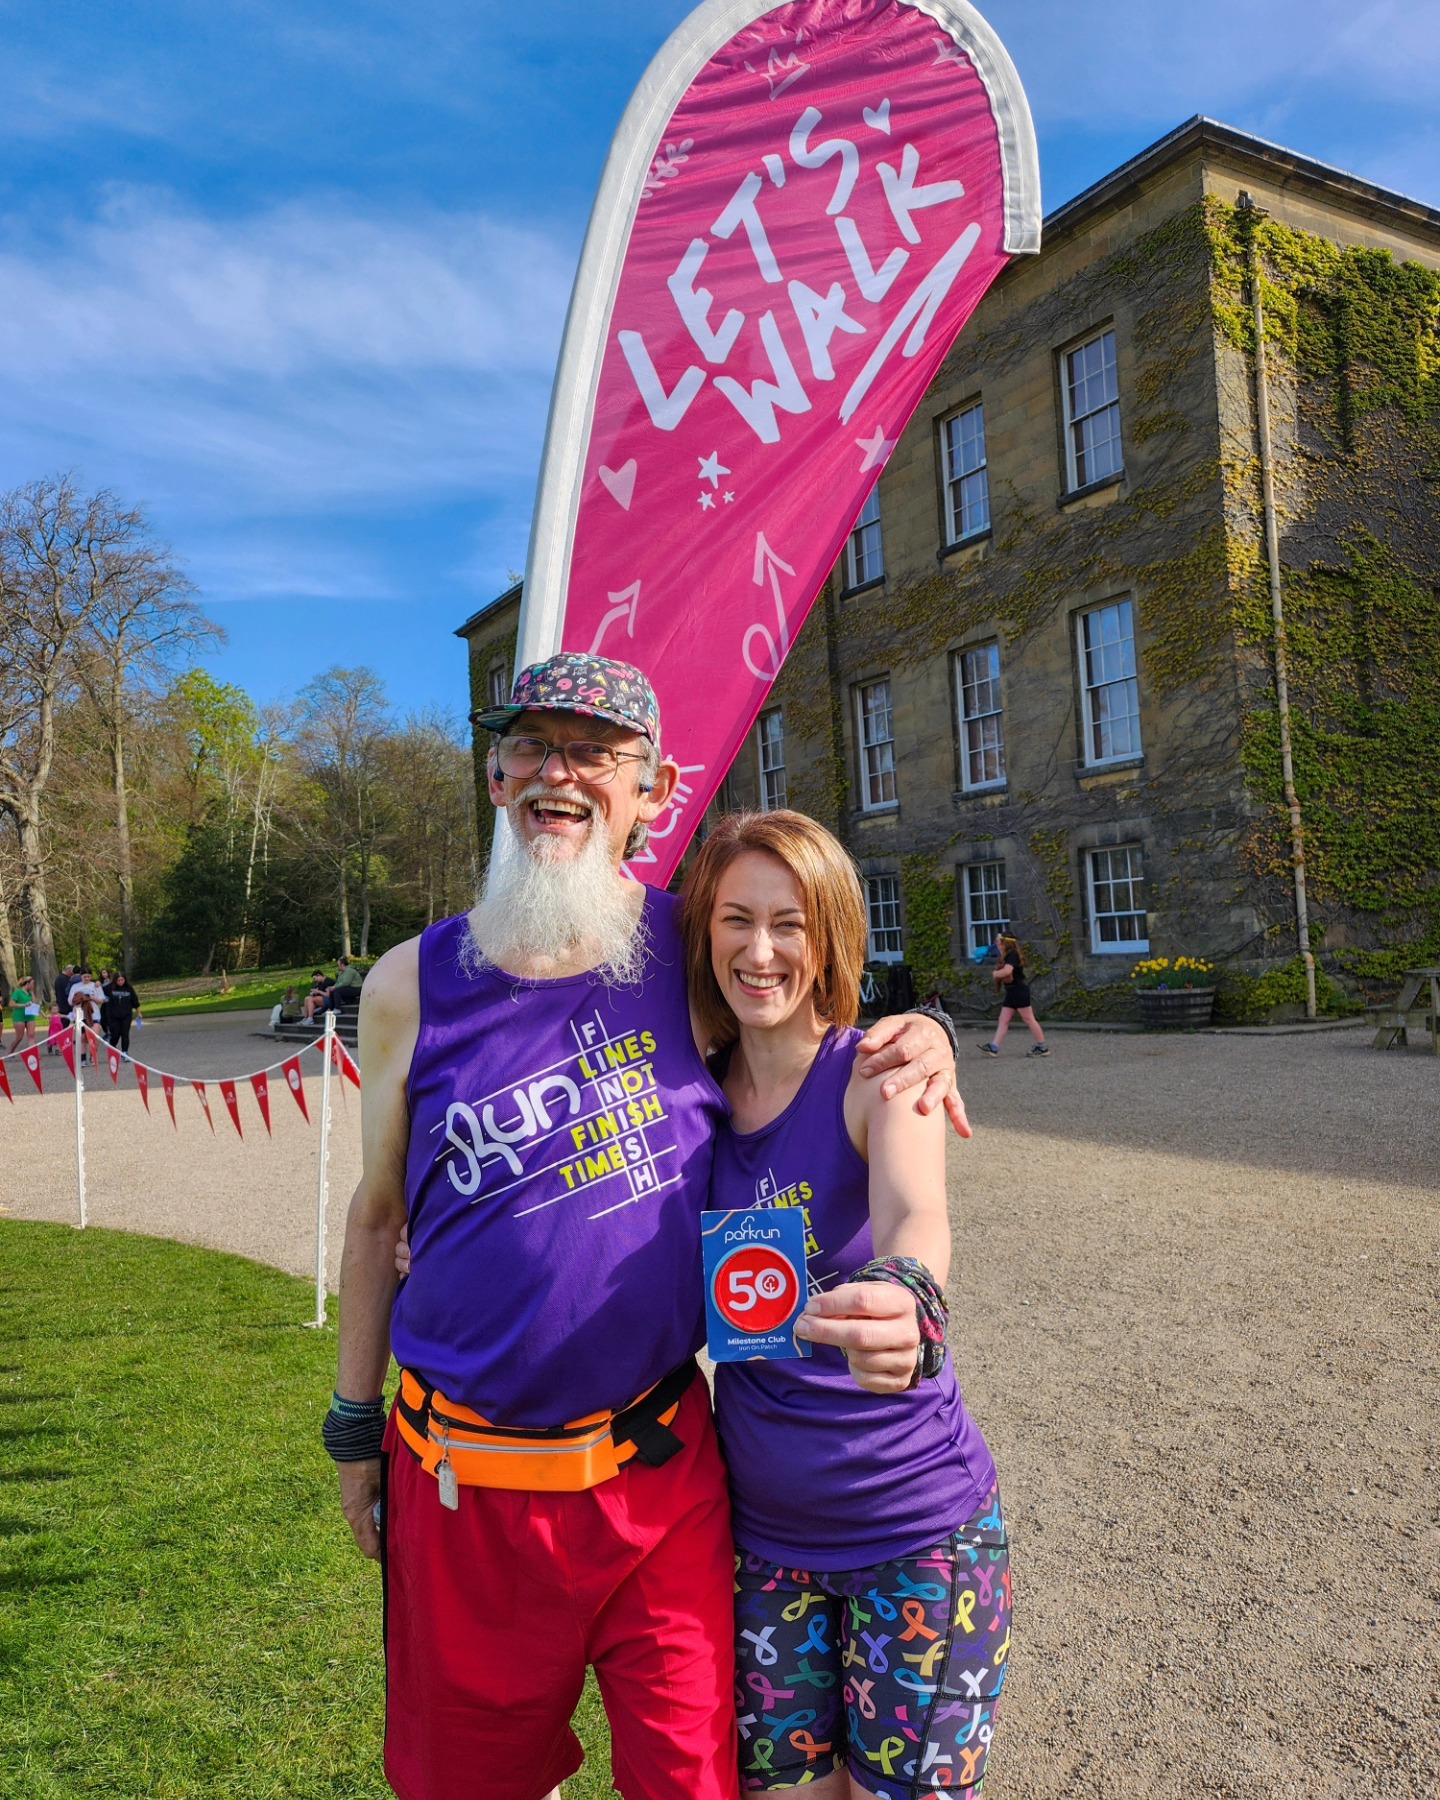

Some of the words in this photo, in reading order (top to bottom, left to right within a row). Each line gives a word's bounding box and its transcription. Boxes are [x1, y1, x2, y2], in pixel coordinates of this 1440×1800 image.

[618, 106, 859, 431] LET'S
[713, 143, 965, 444] WALK
[578, 1030, 657, 1080] LINES
[602, 1063, 657, 1103] NOT
[570, 1094, 664, 1151] FINISH
[559, 1136, 643, 1189] TIMES
[755, 1181, 813, 1209] NES
[724, 1215, 781, 1244] parkrun
[728, 1267, 788, 1312] 50
[727, 1337, 766, 1346] Milestone
[767, 1335, 787, 1344] Club
